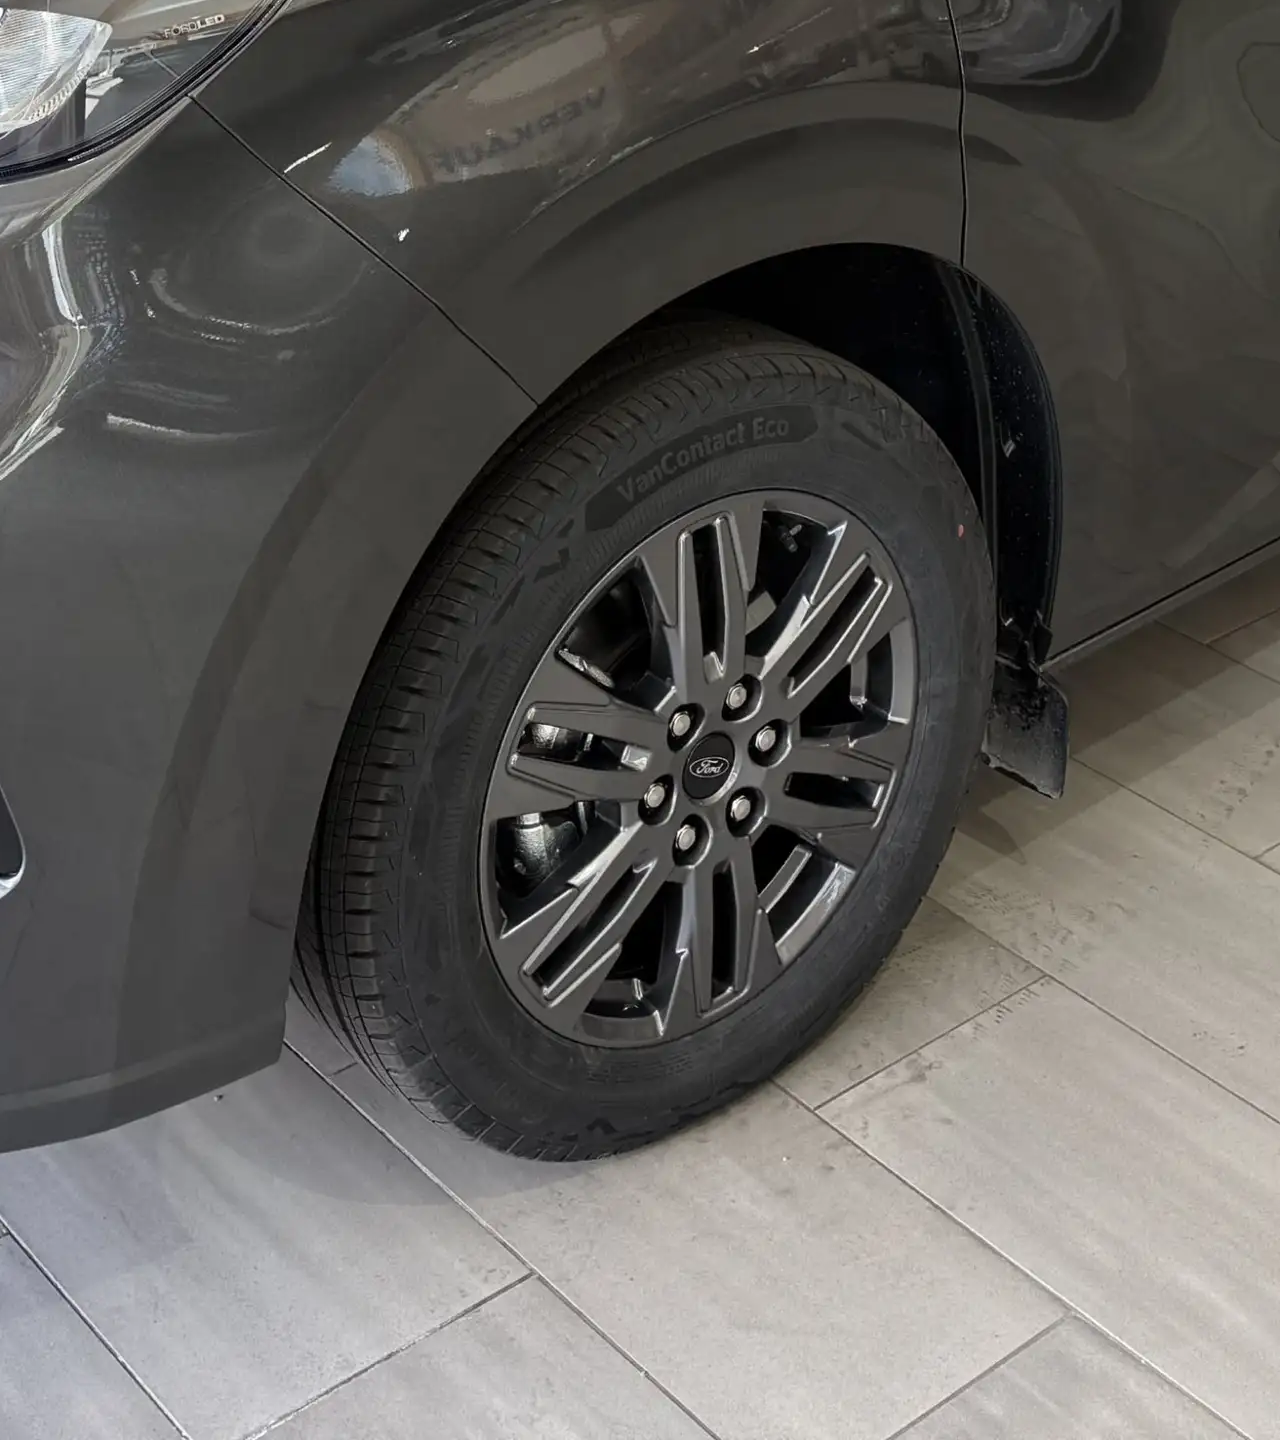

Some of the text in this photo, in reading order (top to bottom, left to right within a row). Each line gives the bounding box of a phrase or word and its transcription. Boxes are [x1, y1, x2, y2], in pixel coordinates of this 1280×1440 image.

[617, 416, 790, 503] VanContact Eco
[696, 759, 724, 774] Ford
